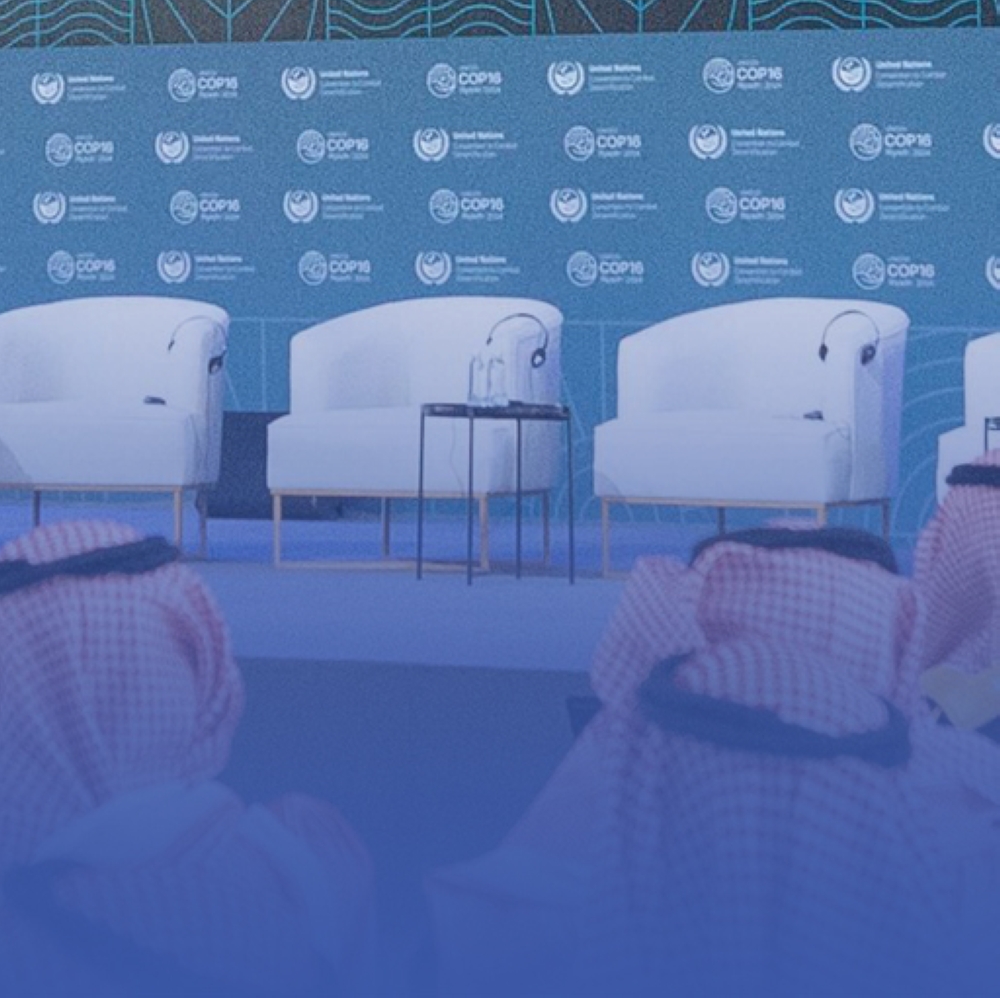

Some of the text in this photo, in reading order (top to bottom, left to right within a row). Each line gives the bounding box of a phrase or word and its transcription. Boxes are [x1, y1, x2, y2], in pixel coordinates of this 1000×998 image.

[737, 67, 783, 81] COP16
[596, 135, 641, 149] COP16
[884, 134, 932, 148] COP16
[739, 198, 785, 211] COP16
[600, 261, 644, 275] COP16
[887, 264, 934, 278] COP16
